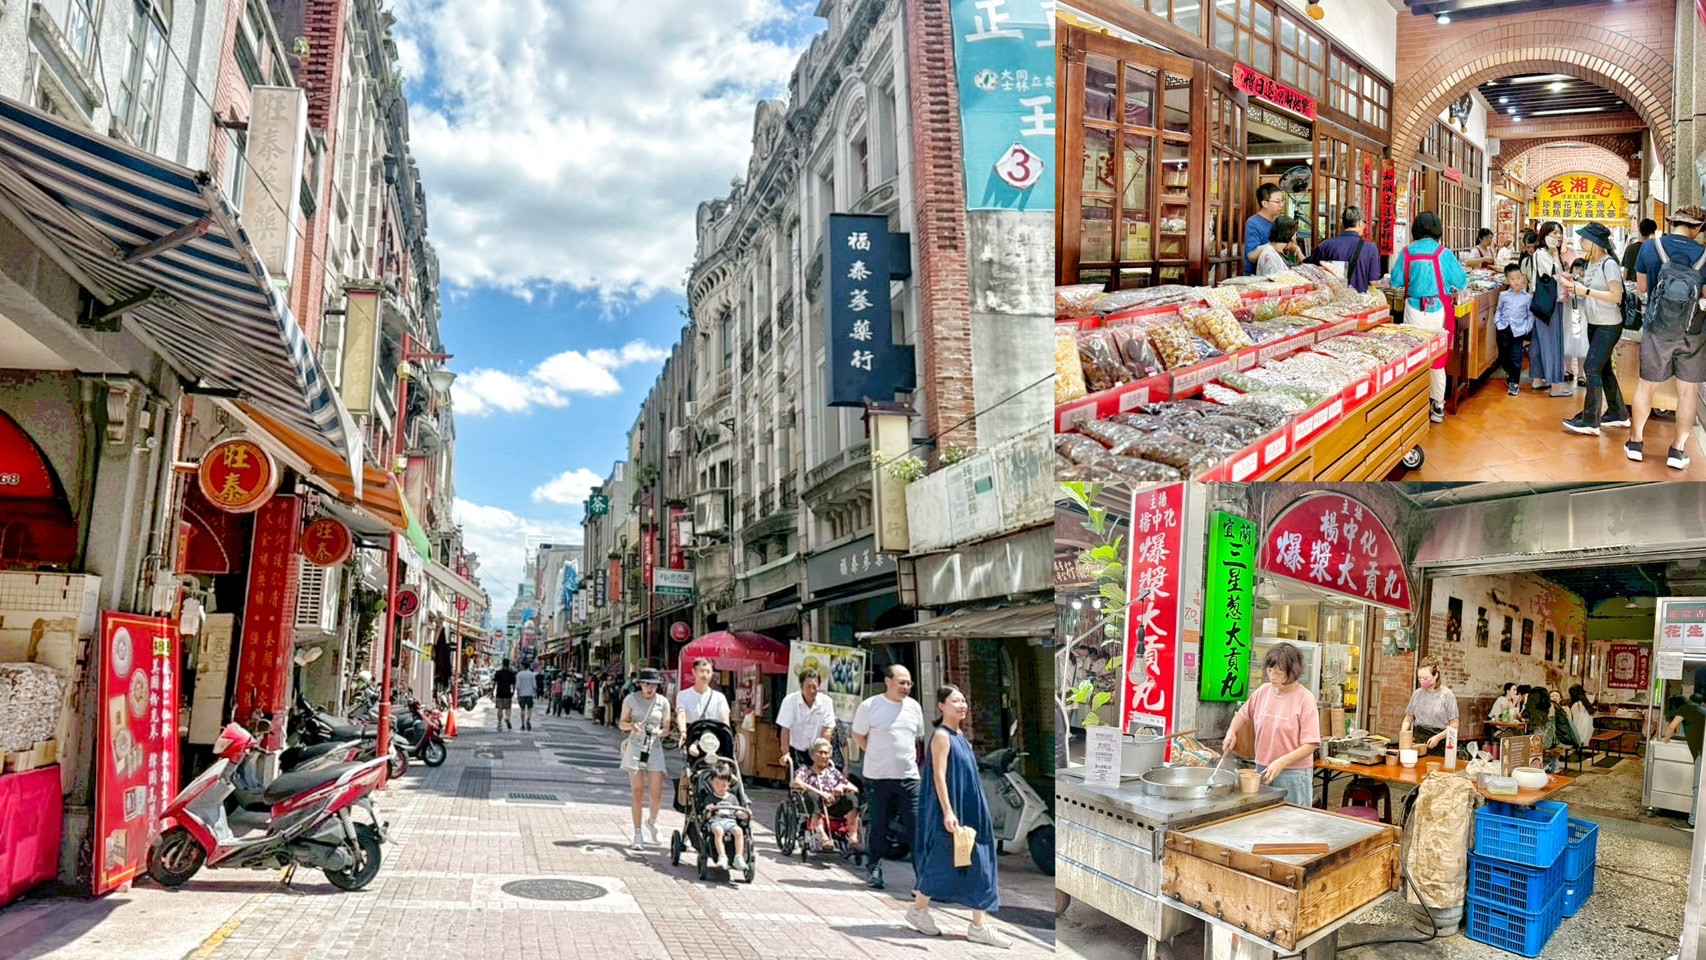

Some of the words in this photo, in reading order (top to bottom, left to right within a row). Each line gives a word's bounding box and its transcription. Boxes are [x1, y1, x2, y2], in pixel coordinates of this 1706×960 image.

[1007, 148, 1031, 182] 3
[1546, 177, 1614, 198] 金湘記
[847, 231, 874, 371] 福泰蔘藥行
[219, 443, 250, 502] 旺泰
[590, 496, 607, 513] 茶
[1150, 490, 1168, 510] 主播
[1341, 498, 1363, 521] 主播
[1139, 508, 1177, 533] 楊中化
[1223, 518, 1251, 545] 宜蘭
[1320, 509, 1378, 558] 楊中化
[315, 522, 334, 561] 旺泰
[1276, 530, 1401, 600] 爆漿大貢丸
[1664, 624, 1704, 638] 花生
